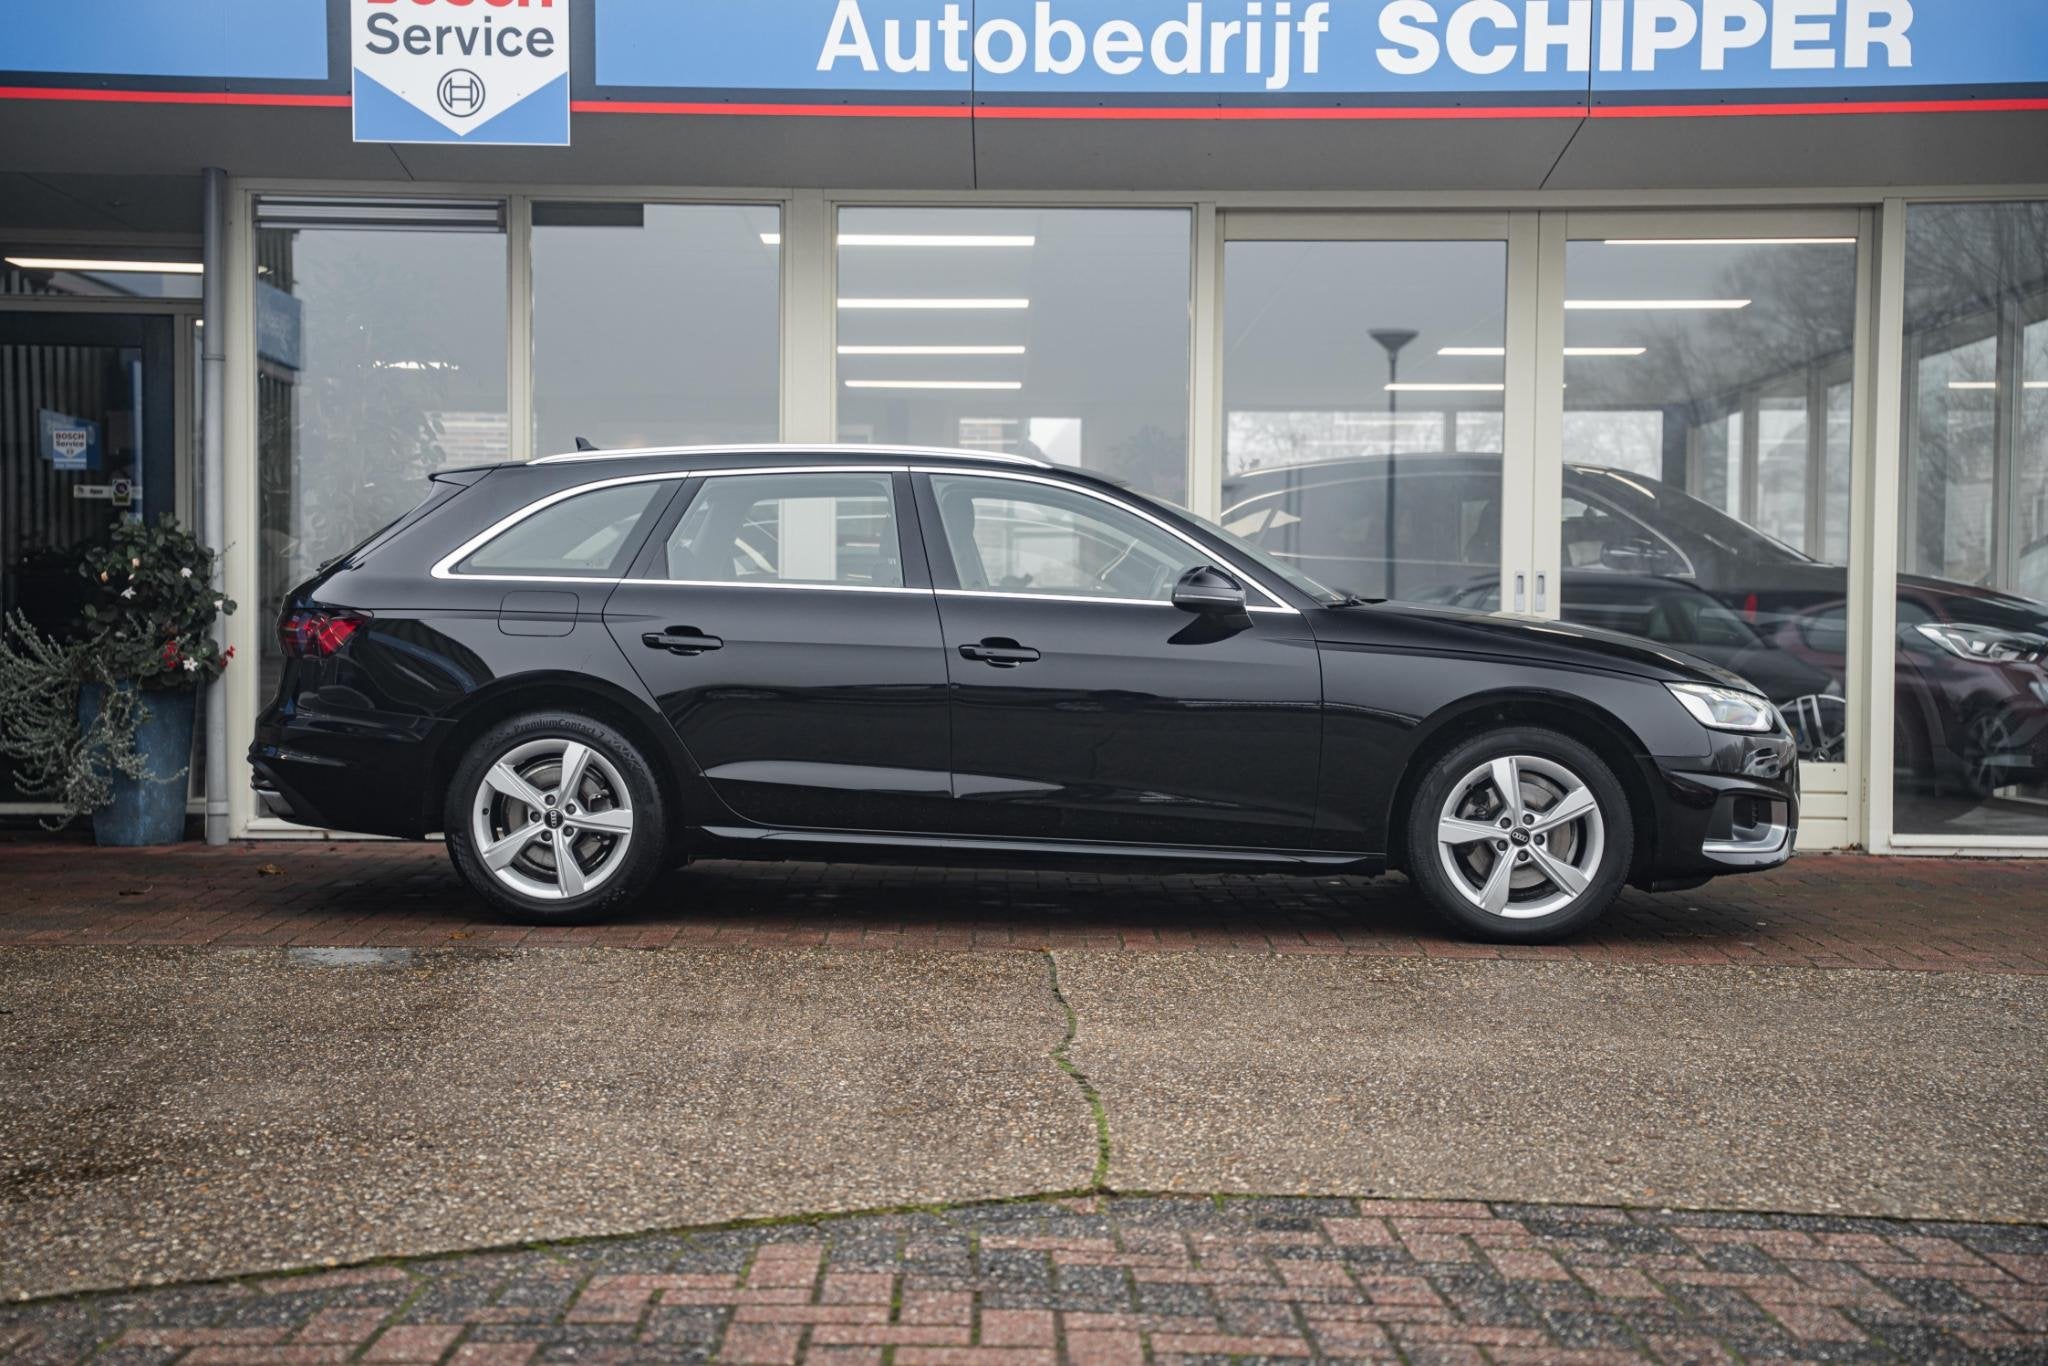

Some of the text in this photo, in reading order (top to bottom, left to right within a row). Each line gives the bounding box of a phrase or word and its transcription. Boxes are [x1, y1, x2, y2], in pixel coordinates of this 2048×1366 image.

[365, 12, 555, 58] Service
[816, 0, 1914, 89] Autobedrijf SCHIPPER
[55, 432, 85, 440] BOSCH
[55, 440, 85, 448] Service
[513, 718, 596, 735] PremiumContact
